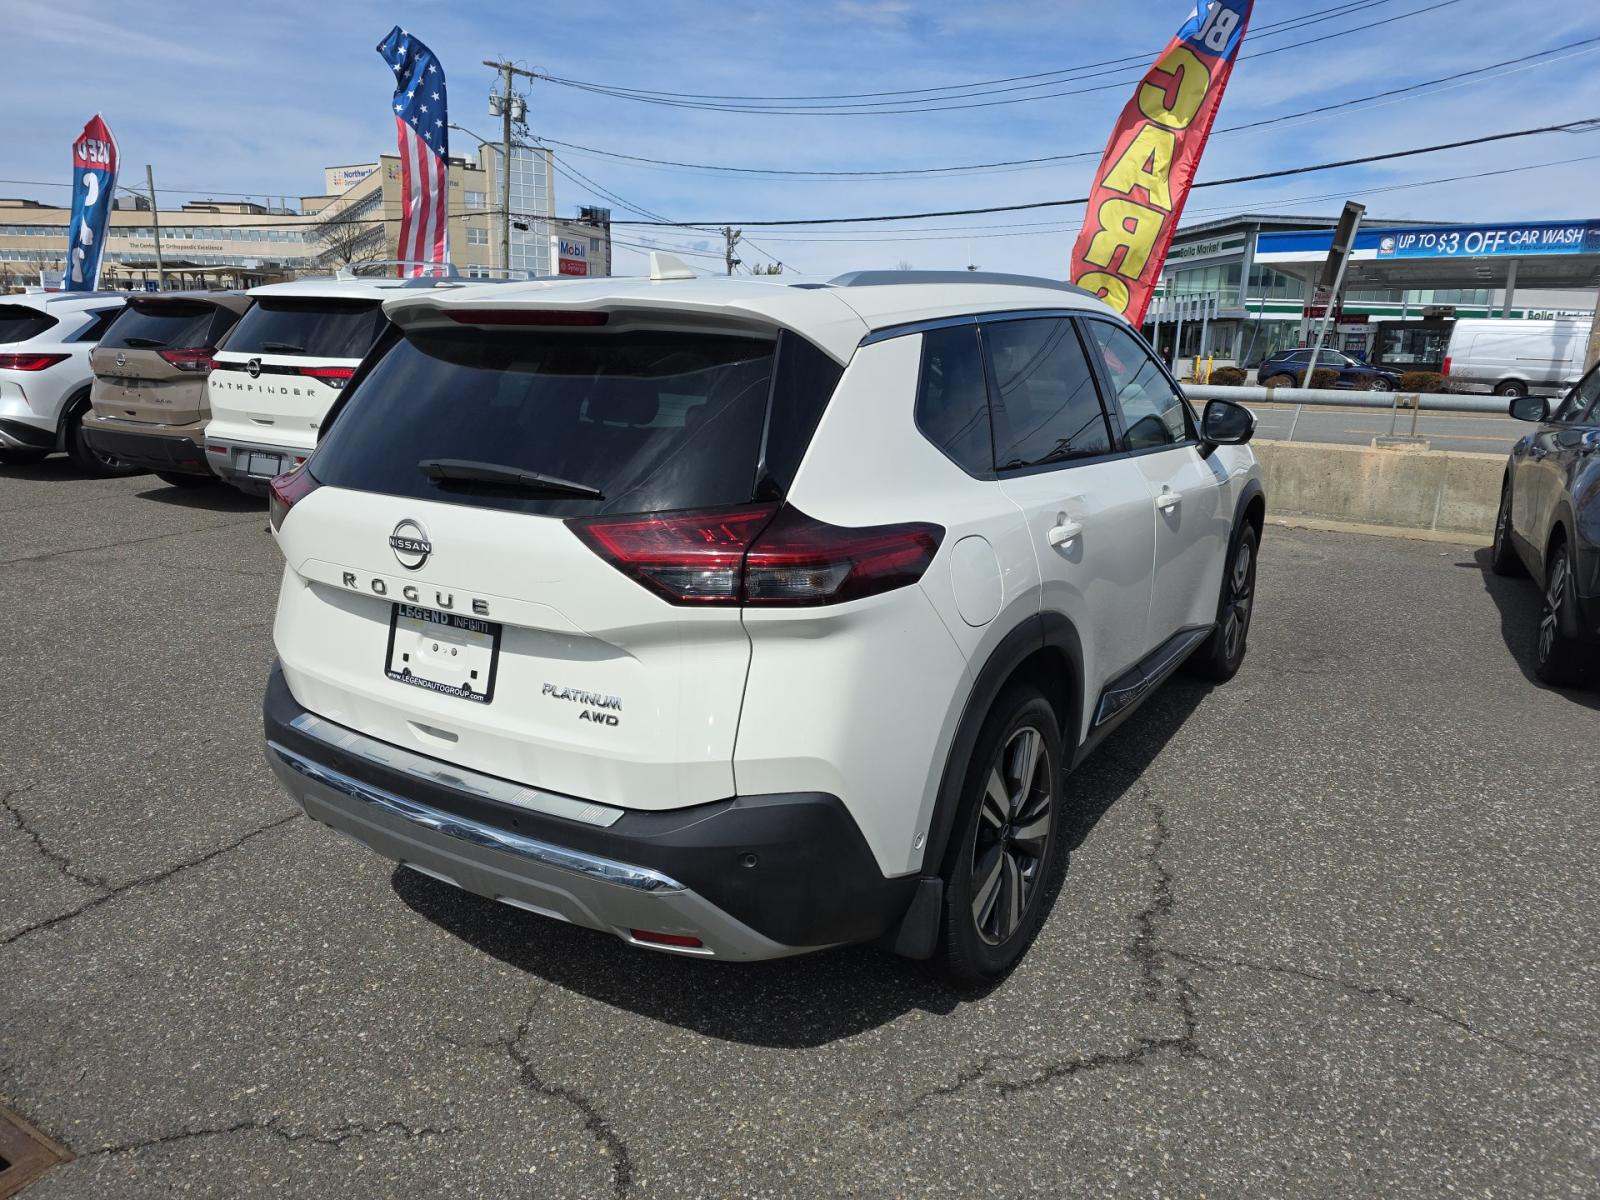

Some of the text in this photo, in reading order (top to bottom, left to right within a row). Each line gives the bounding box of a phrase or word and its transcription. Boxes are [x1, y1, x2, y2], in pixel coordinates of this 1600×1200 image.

[560, 240, 585, 257] Mobil
[1398, 234, 1416, 249] UP
[1419, 233, 1437, 248] TO
[1438, 232, 1460, 255] $3
[1464, 231, 1507, 253] OFF
[1508, 230, 1540, 245] CAR
[1541, 228, 1585, 244] WASH
[212, 380, 316, 398] PATHFINDER
[389, 537, 430, 553] NISSAN
[342, 571, 491, 617] ROGUE
[399, 604, 489, 633] LEGEND INFINITI
[387, 671, 485, 702] www.LEGENDAUTOGROUP.com
[541, 682, 623, 712] PLATINUM
[578, 709, 620, 727] AWD
